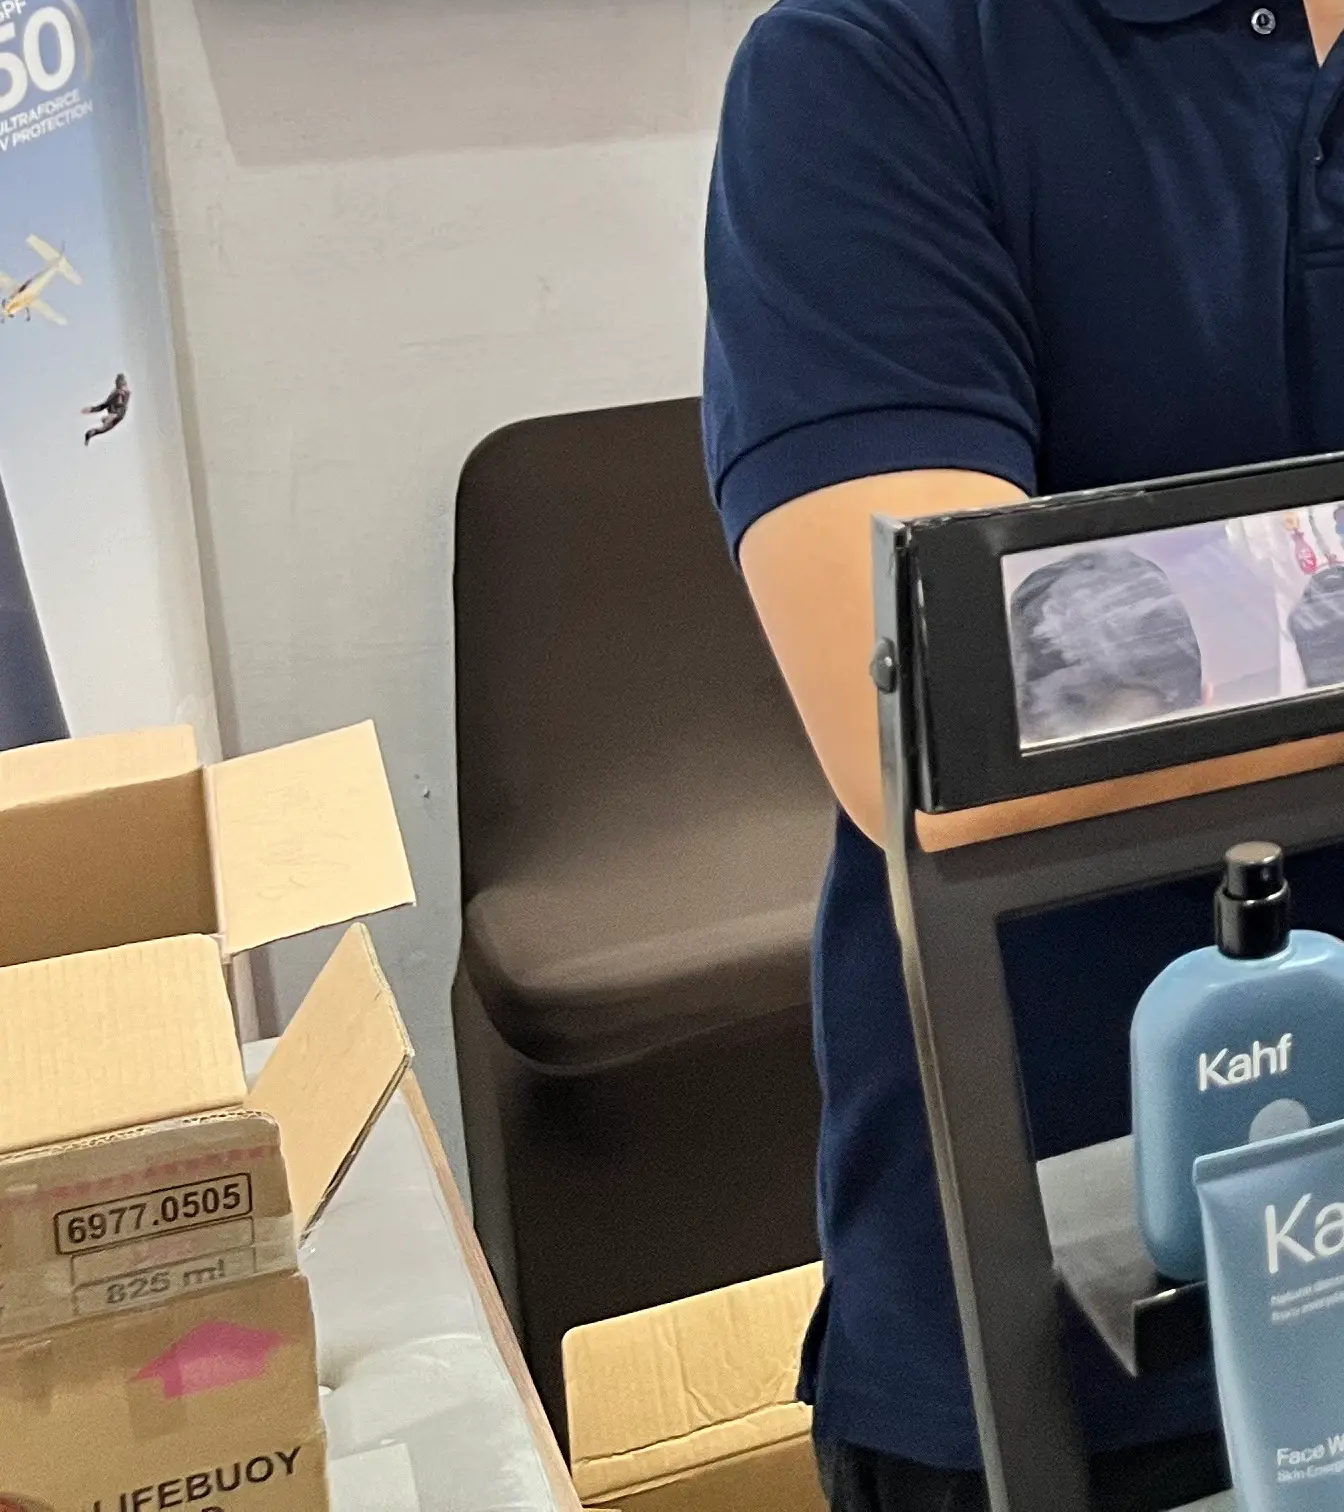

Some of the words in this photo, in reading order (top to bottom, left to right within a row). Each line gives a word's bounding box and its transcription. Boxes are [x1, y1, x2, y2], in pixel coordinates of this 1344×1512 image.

[12, 99, 94, 147] PROTECTION
[1198, 1032, 1292, 1092] Kahf
[67, 1183, 241, 1244] 6977.0505
[106, 1270, 169, 1305] 825
[1276, 1445, 1324, 1466] Face
